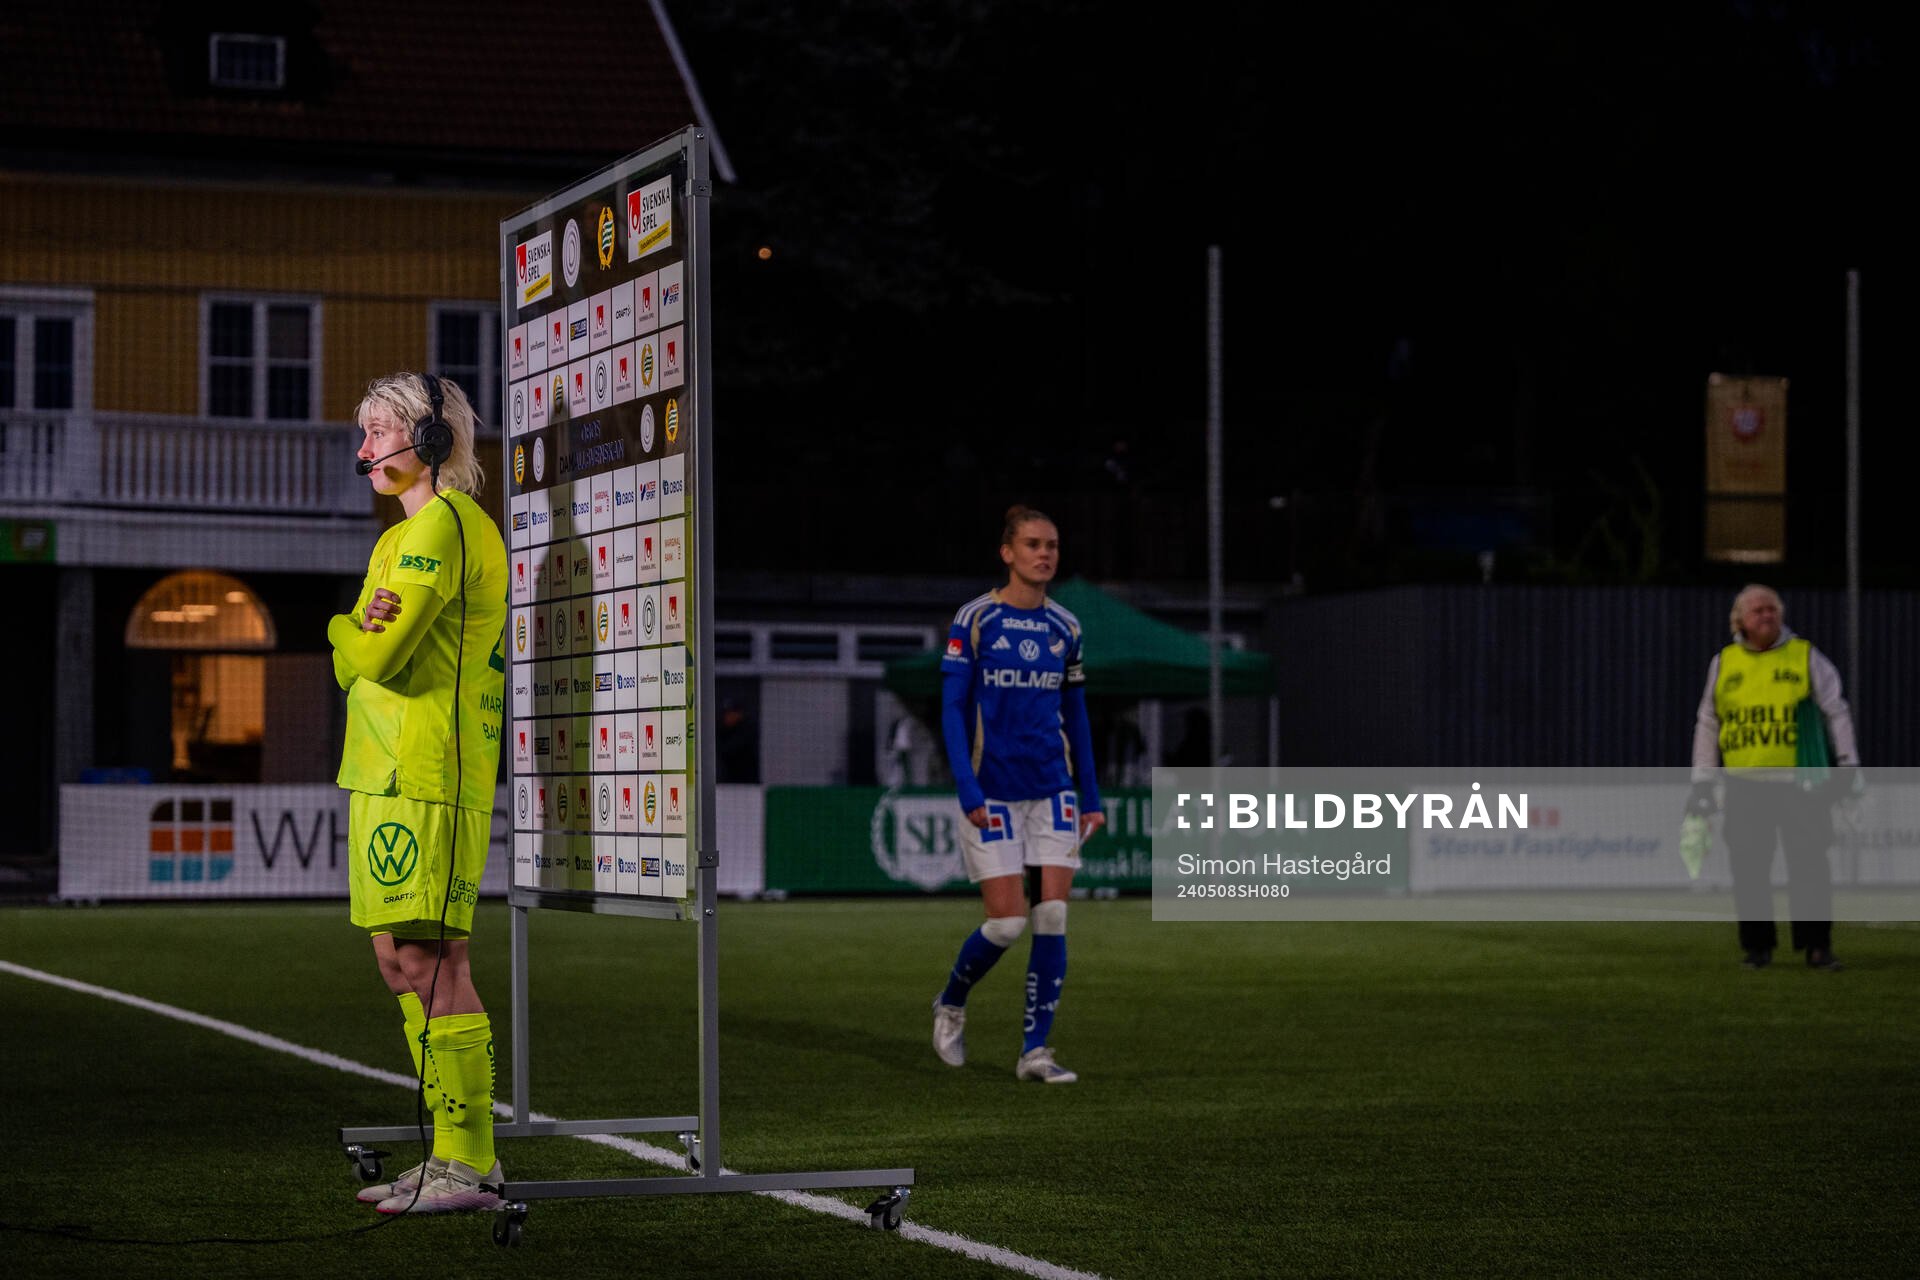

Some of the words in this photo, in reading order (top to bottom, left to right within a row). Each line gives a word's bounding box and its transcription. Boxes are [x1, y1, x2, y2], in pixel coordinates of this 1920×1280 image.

[643, 187, 671, 214] SVENSKA
[643, 216, 658, 233] SPEL
[528, 241, 551, 265] SVENSKA
[528, 265, 540, 282] SPEL
[646, 481, 656, 491] INTER
[669, 479, 683, 495] OBOS
[622, 491, 635, 505] OBOS
[646, 489, 656, 500] SPORT
[578, 502, 590, 515] OBOS
[537, 511, 548, 526] OBOS
[399, 554, 442, 574] BST
[1002, 618, 1050, 633] stadium
[624, 674, 636, 688] OBOS
[671, 669, 684, 684] OBOS
[480, 692, 504, 714] MAR
[625, 861, 637, 874] OBOS
[672, 863, 685, 877] OBOS
[384, 892, 411, 904] CRAFT
